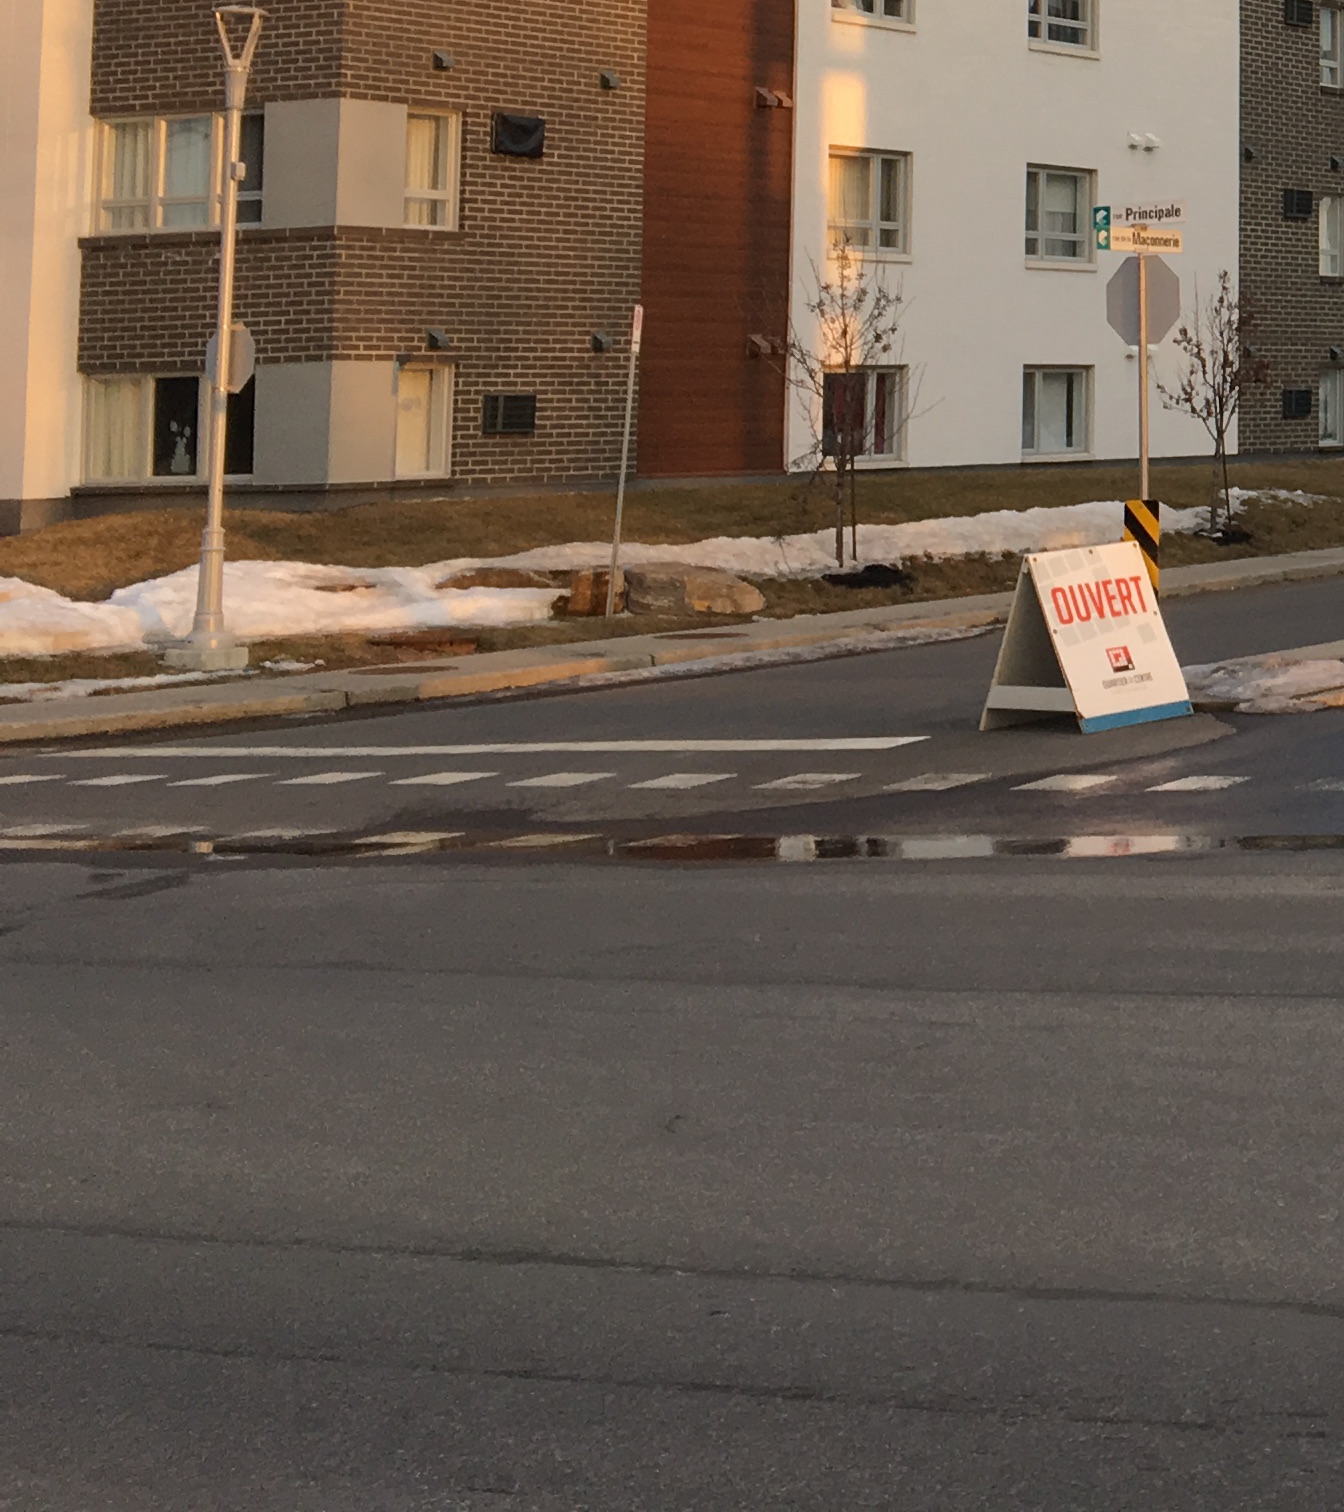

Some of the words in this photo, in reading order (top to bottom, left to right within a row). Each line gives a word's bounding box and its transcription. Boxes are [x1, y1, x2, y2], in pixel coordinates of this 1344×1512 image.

[1125, 204, 1181, 221] Principale
[1132, 232, 1179, 248] Maçonnerie
[1051, 576, 1148, 625] OUVERT
